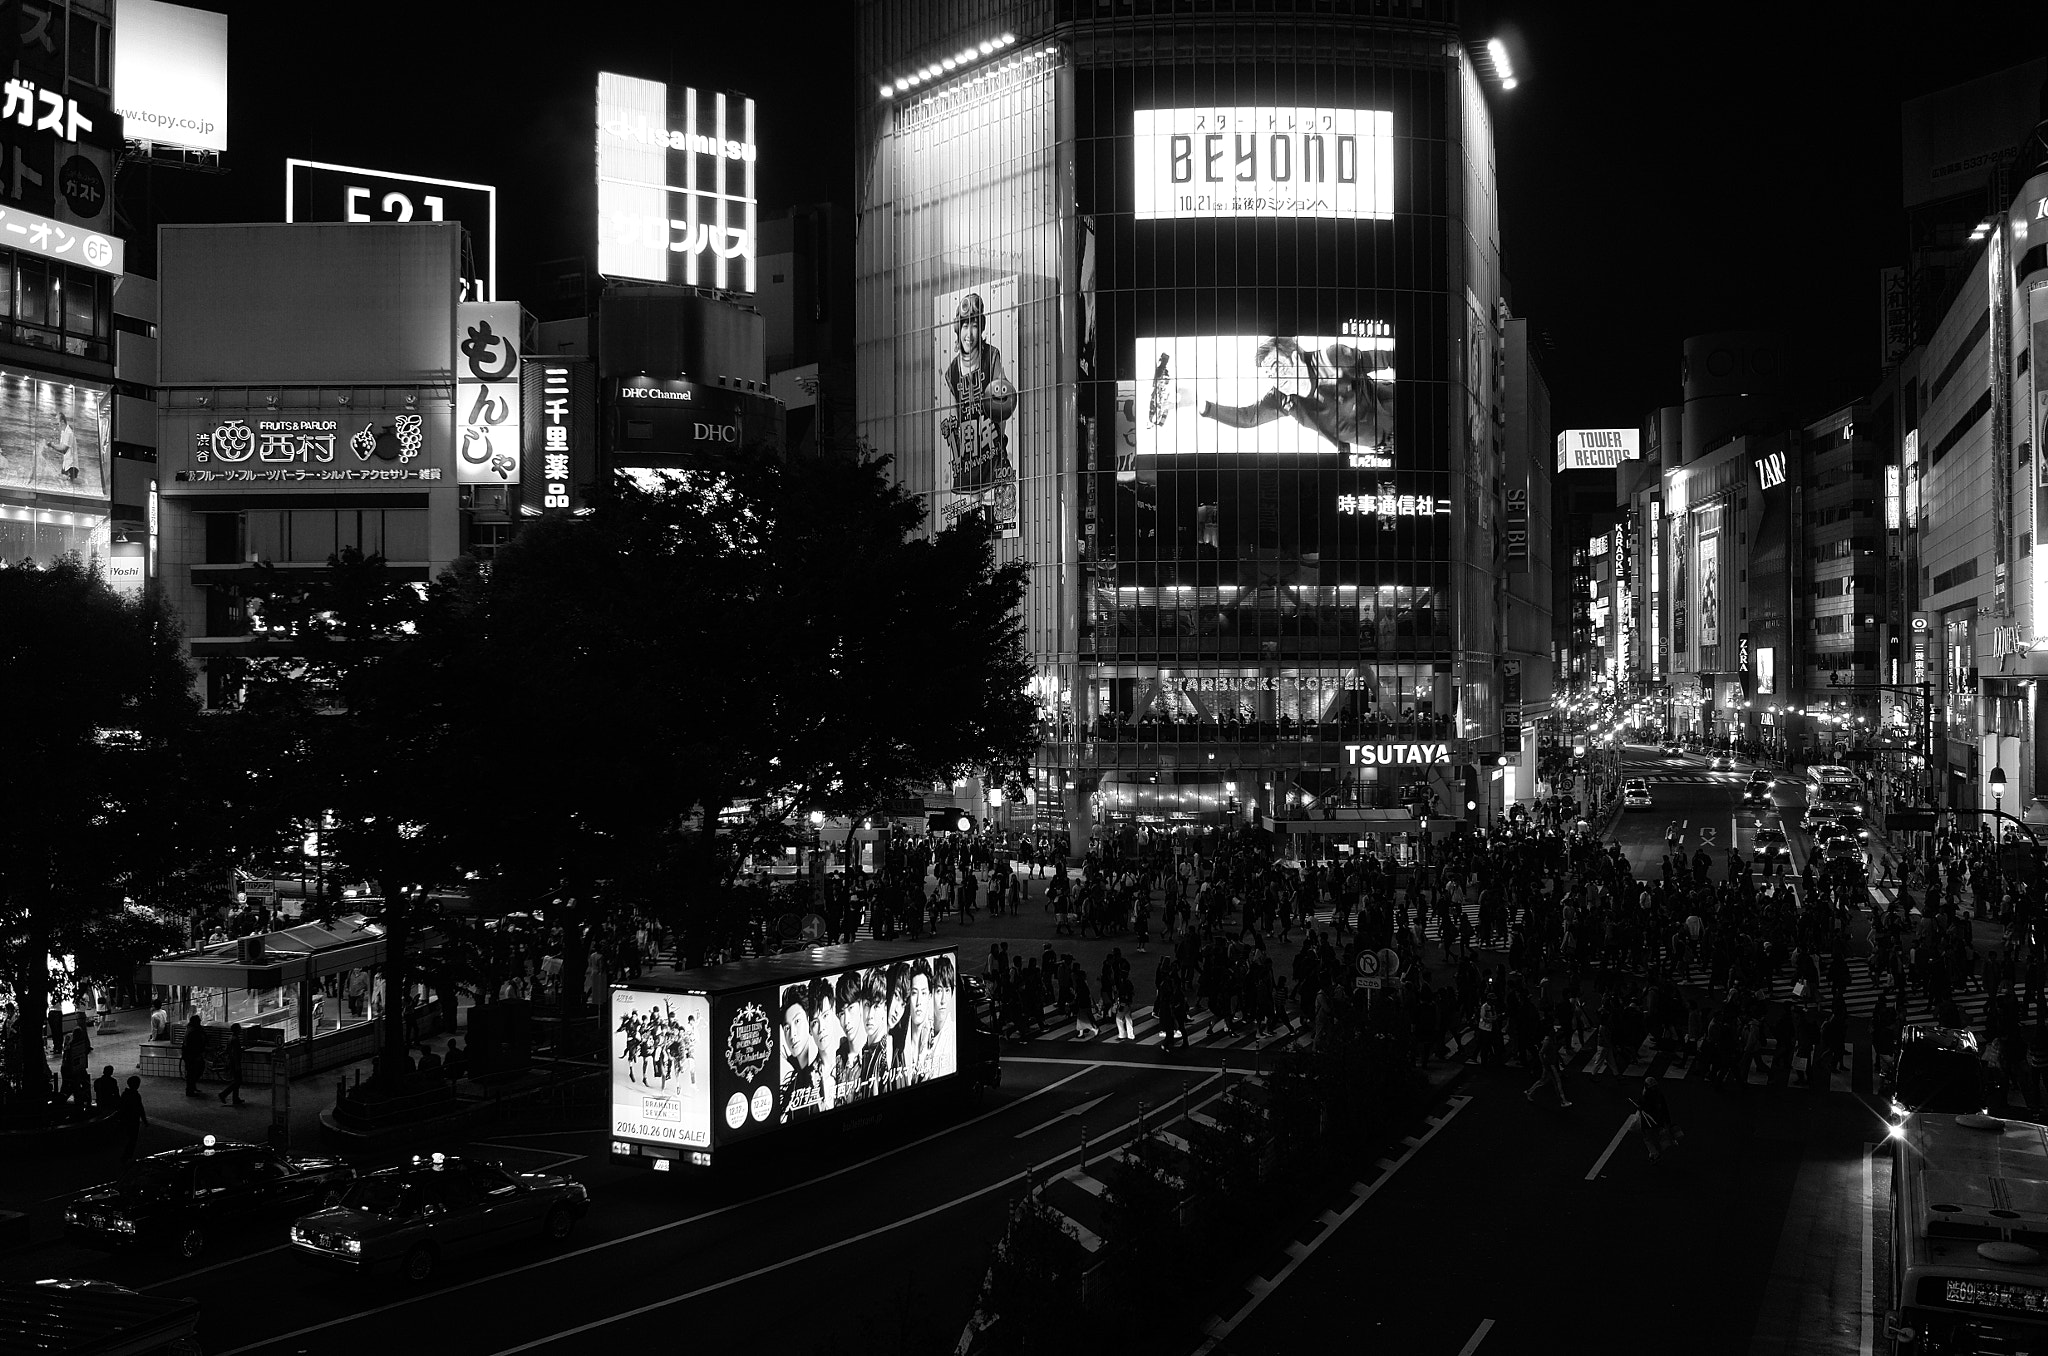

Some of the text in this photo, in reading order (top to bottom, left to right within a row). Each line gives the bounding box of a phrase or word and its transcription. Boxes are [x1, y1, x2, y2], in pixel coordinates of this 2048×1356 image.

[2, 78, 93, 142] ガスト
[1171, 134, 1357, 184] BEYOND
[67, 180, 101, 202] ガスト
[461, 320, 517, 480] もんじゃ
[622, 387, 692, 401] DHC Channel
[544, 368, 570, 508] 三千里薬品
[693, 422, 736, 443] DHC
[1579, 432, 1622, 448] TOWER
[260, 433, 337, 463] 西村
[1575, 449, 1630, 466] RECORDS
[1615, 523, 1625, 577] KARAOKE
[1739, 639, 1749, 672] ZARA
[1161, 676, 1365, 692] STARBUCKS COFFEE
[1344, 743, 1451, 765] TSUTAYA
[617, 1121, 706, 1143] 2016.10.26 ON SALE!
